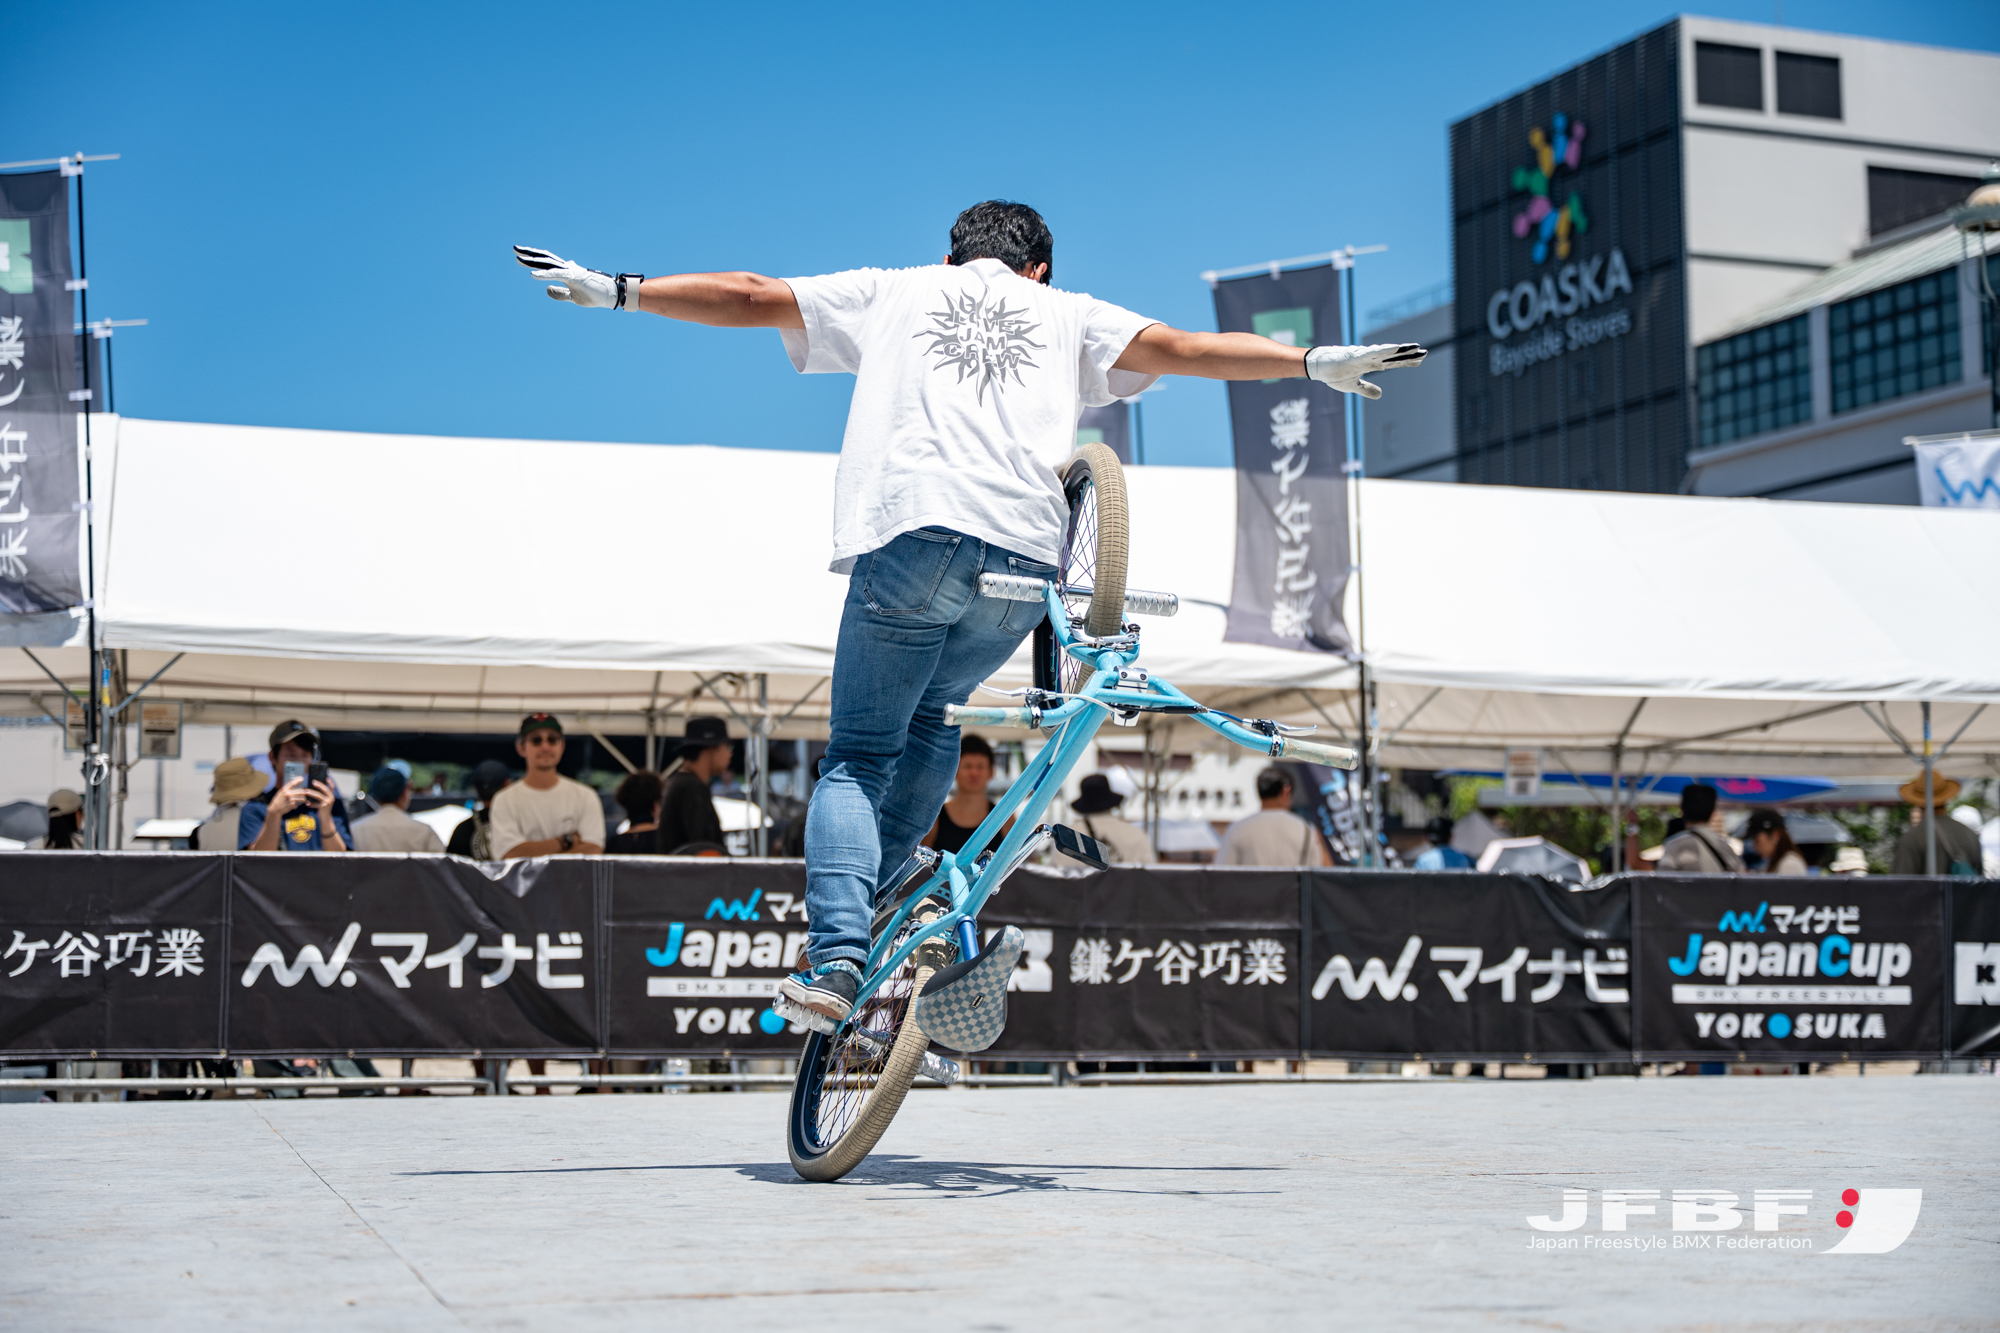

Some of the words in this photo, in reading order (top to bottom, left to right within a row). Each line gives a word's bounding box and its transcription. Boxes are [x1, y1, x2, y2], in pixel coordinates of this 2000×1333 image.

[1487, 248, 1633, 339] COASKA
[953, 310, 1015, 335] LOVE
[960, 328, 1006, 350] JAM
[1489, 325, 1564, 376] Bayside
[1566, 308, 1632, 352] Stores
[944, 342, 1019, 369] CREW
[1769, 905, 1860, 934] マイナビ
[0, 929, 204, 978] ケ谷巧業
[371, 932, 584, 989] マイナビ
[1069, 937, 1287, 985] 鎌ケ谷巧業
[1430, 946, 1629, 1003] マイナビ
[1668, 933, 1912, 986] JapanCup
[677, 983, 728, 993] BMX
[1696, 991, 1740, 1001] BMX
[1756, 991, 1887, 1002] FREESTYLE
